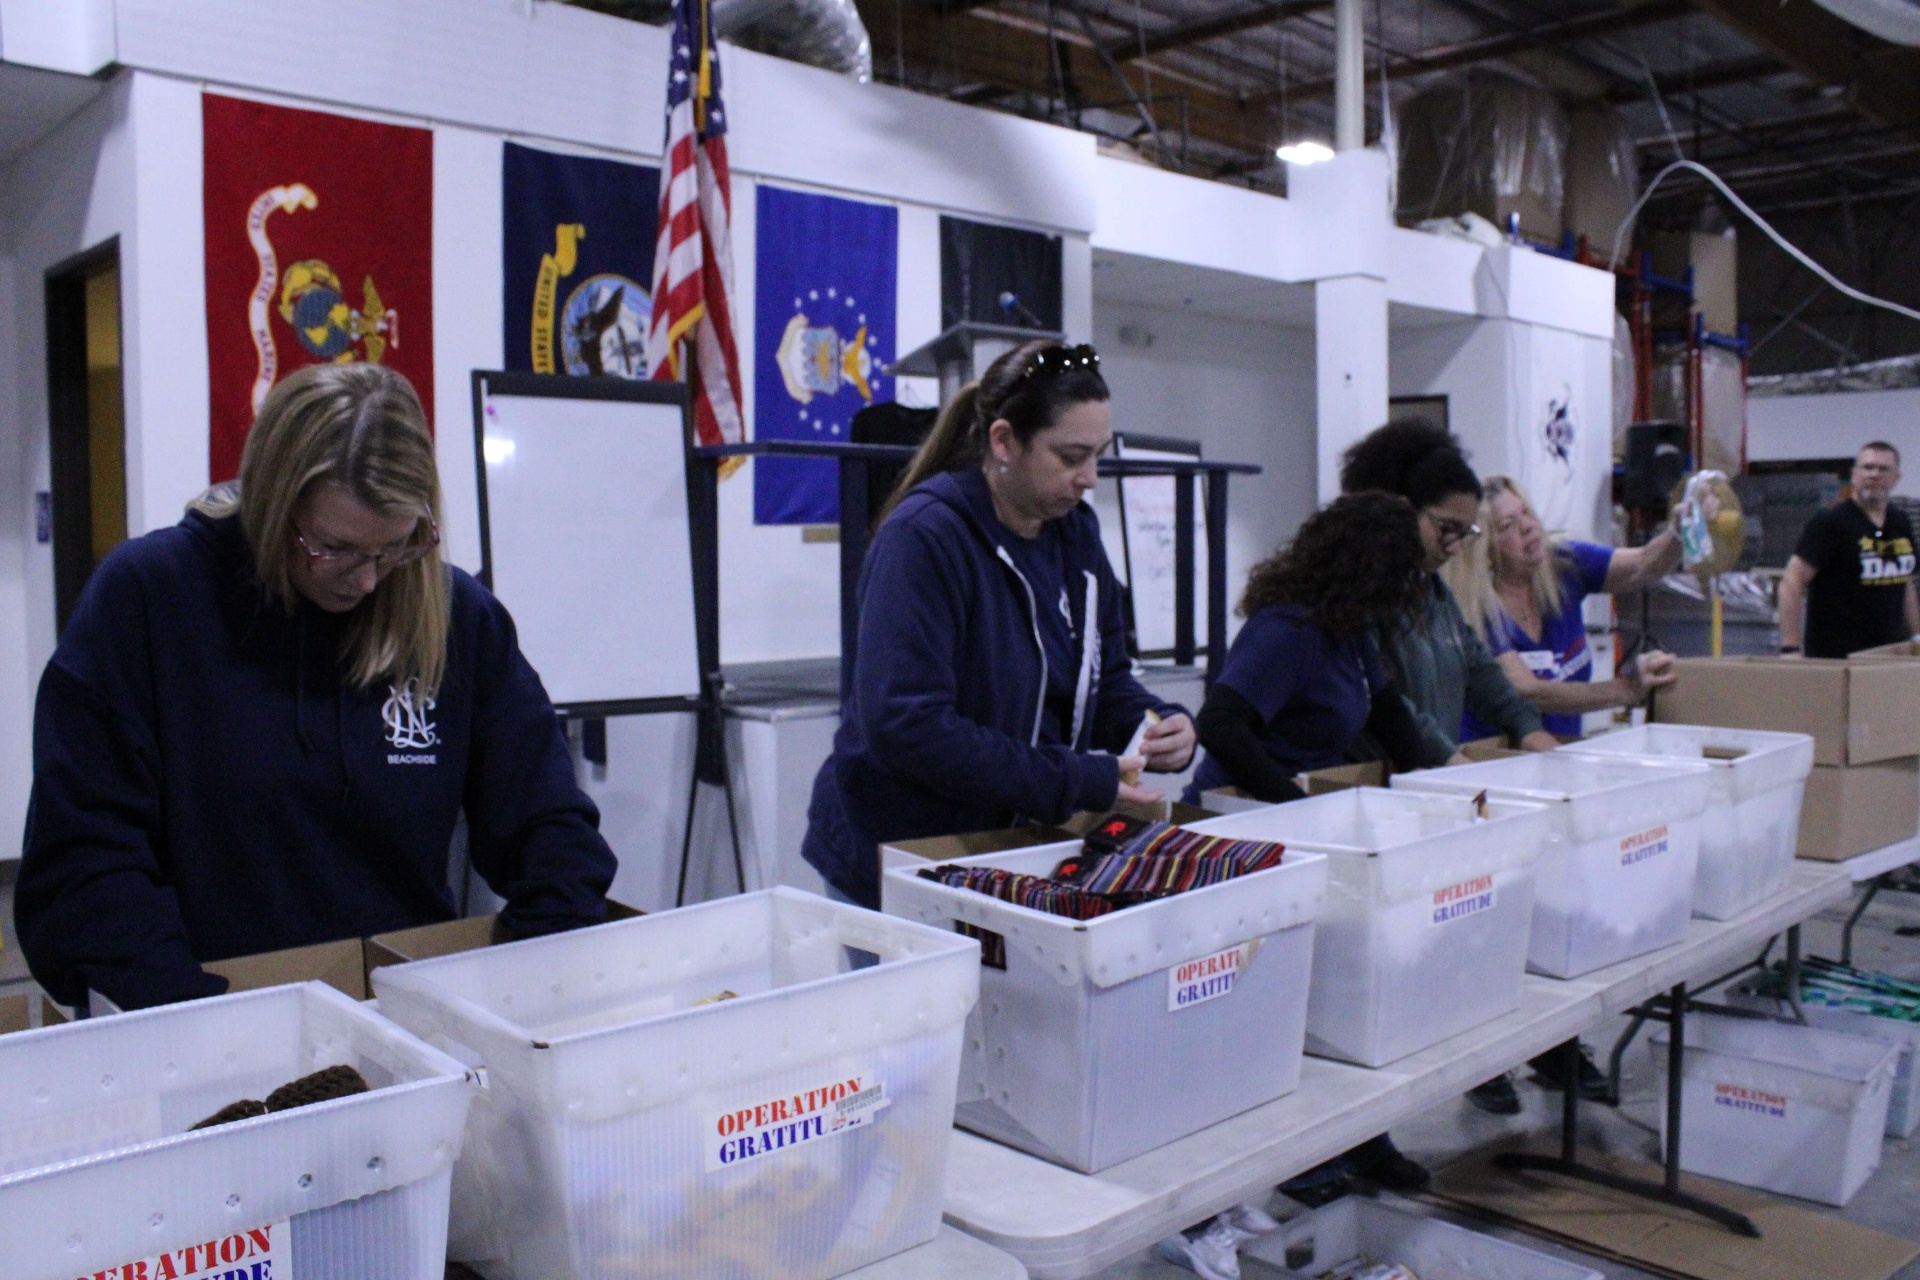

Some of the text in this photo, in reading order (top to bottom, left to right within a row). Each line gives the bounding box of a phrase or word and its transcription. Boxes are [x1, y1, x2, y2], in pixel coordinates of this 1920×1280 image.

[536, 327, 549, 369] STATE
[1860, 553, 1916, 579] DAD
[387, 754, 437, 765] BEACHSIDE
[1621, 825, 1668, 851] OPERATION
[1433, 874, 1493, 906] OPERATION
[1433, 892, 1493, 923] GRATITUDE
[717, 1077, 862, 1137] OPERATION
[1714, 1097, 1785, 1118] GRATITUDE
[1715, 1084, 1786, 1107] OPERATION
[719, 1114, 862, 1164] GRATITU
